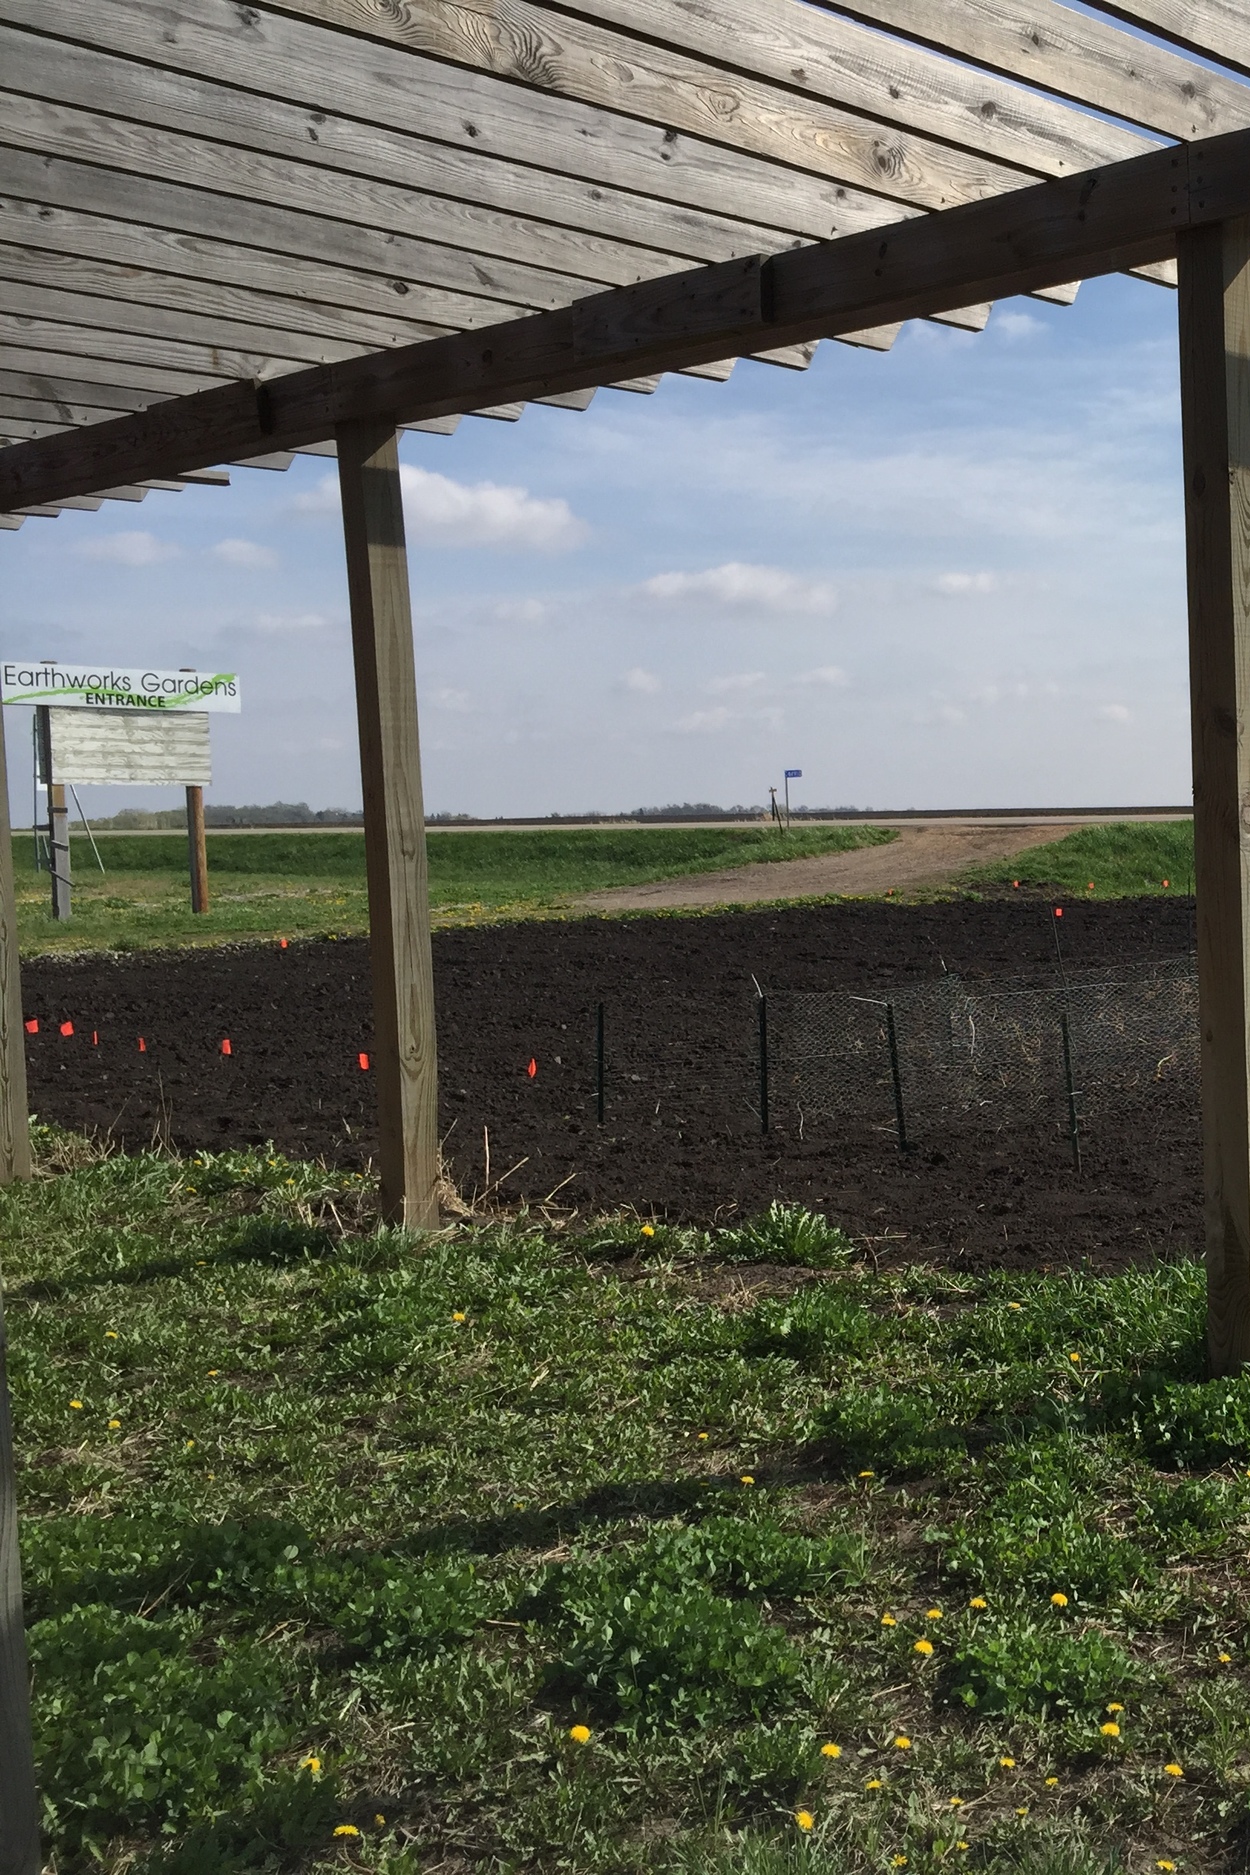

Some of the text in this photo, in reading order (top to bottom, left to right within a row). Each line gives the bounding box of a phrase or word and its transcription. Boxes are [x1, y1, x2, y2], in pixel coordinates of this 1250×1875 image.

[4, 665, 236, 696] Earthworks Gardens
[86, 693, 166, 707] ENTRANCE
